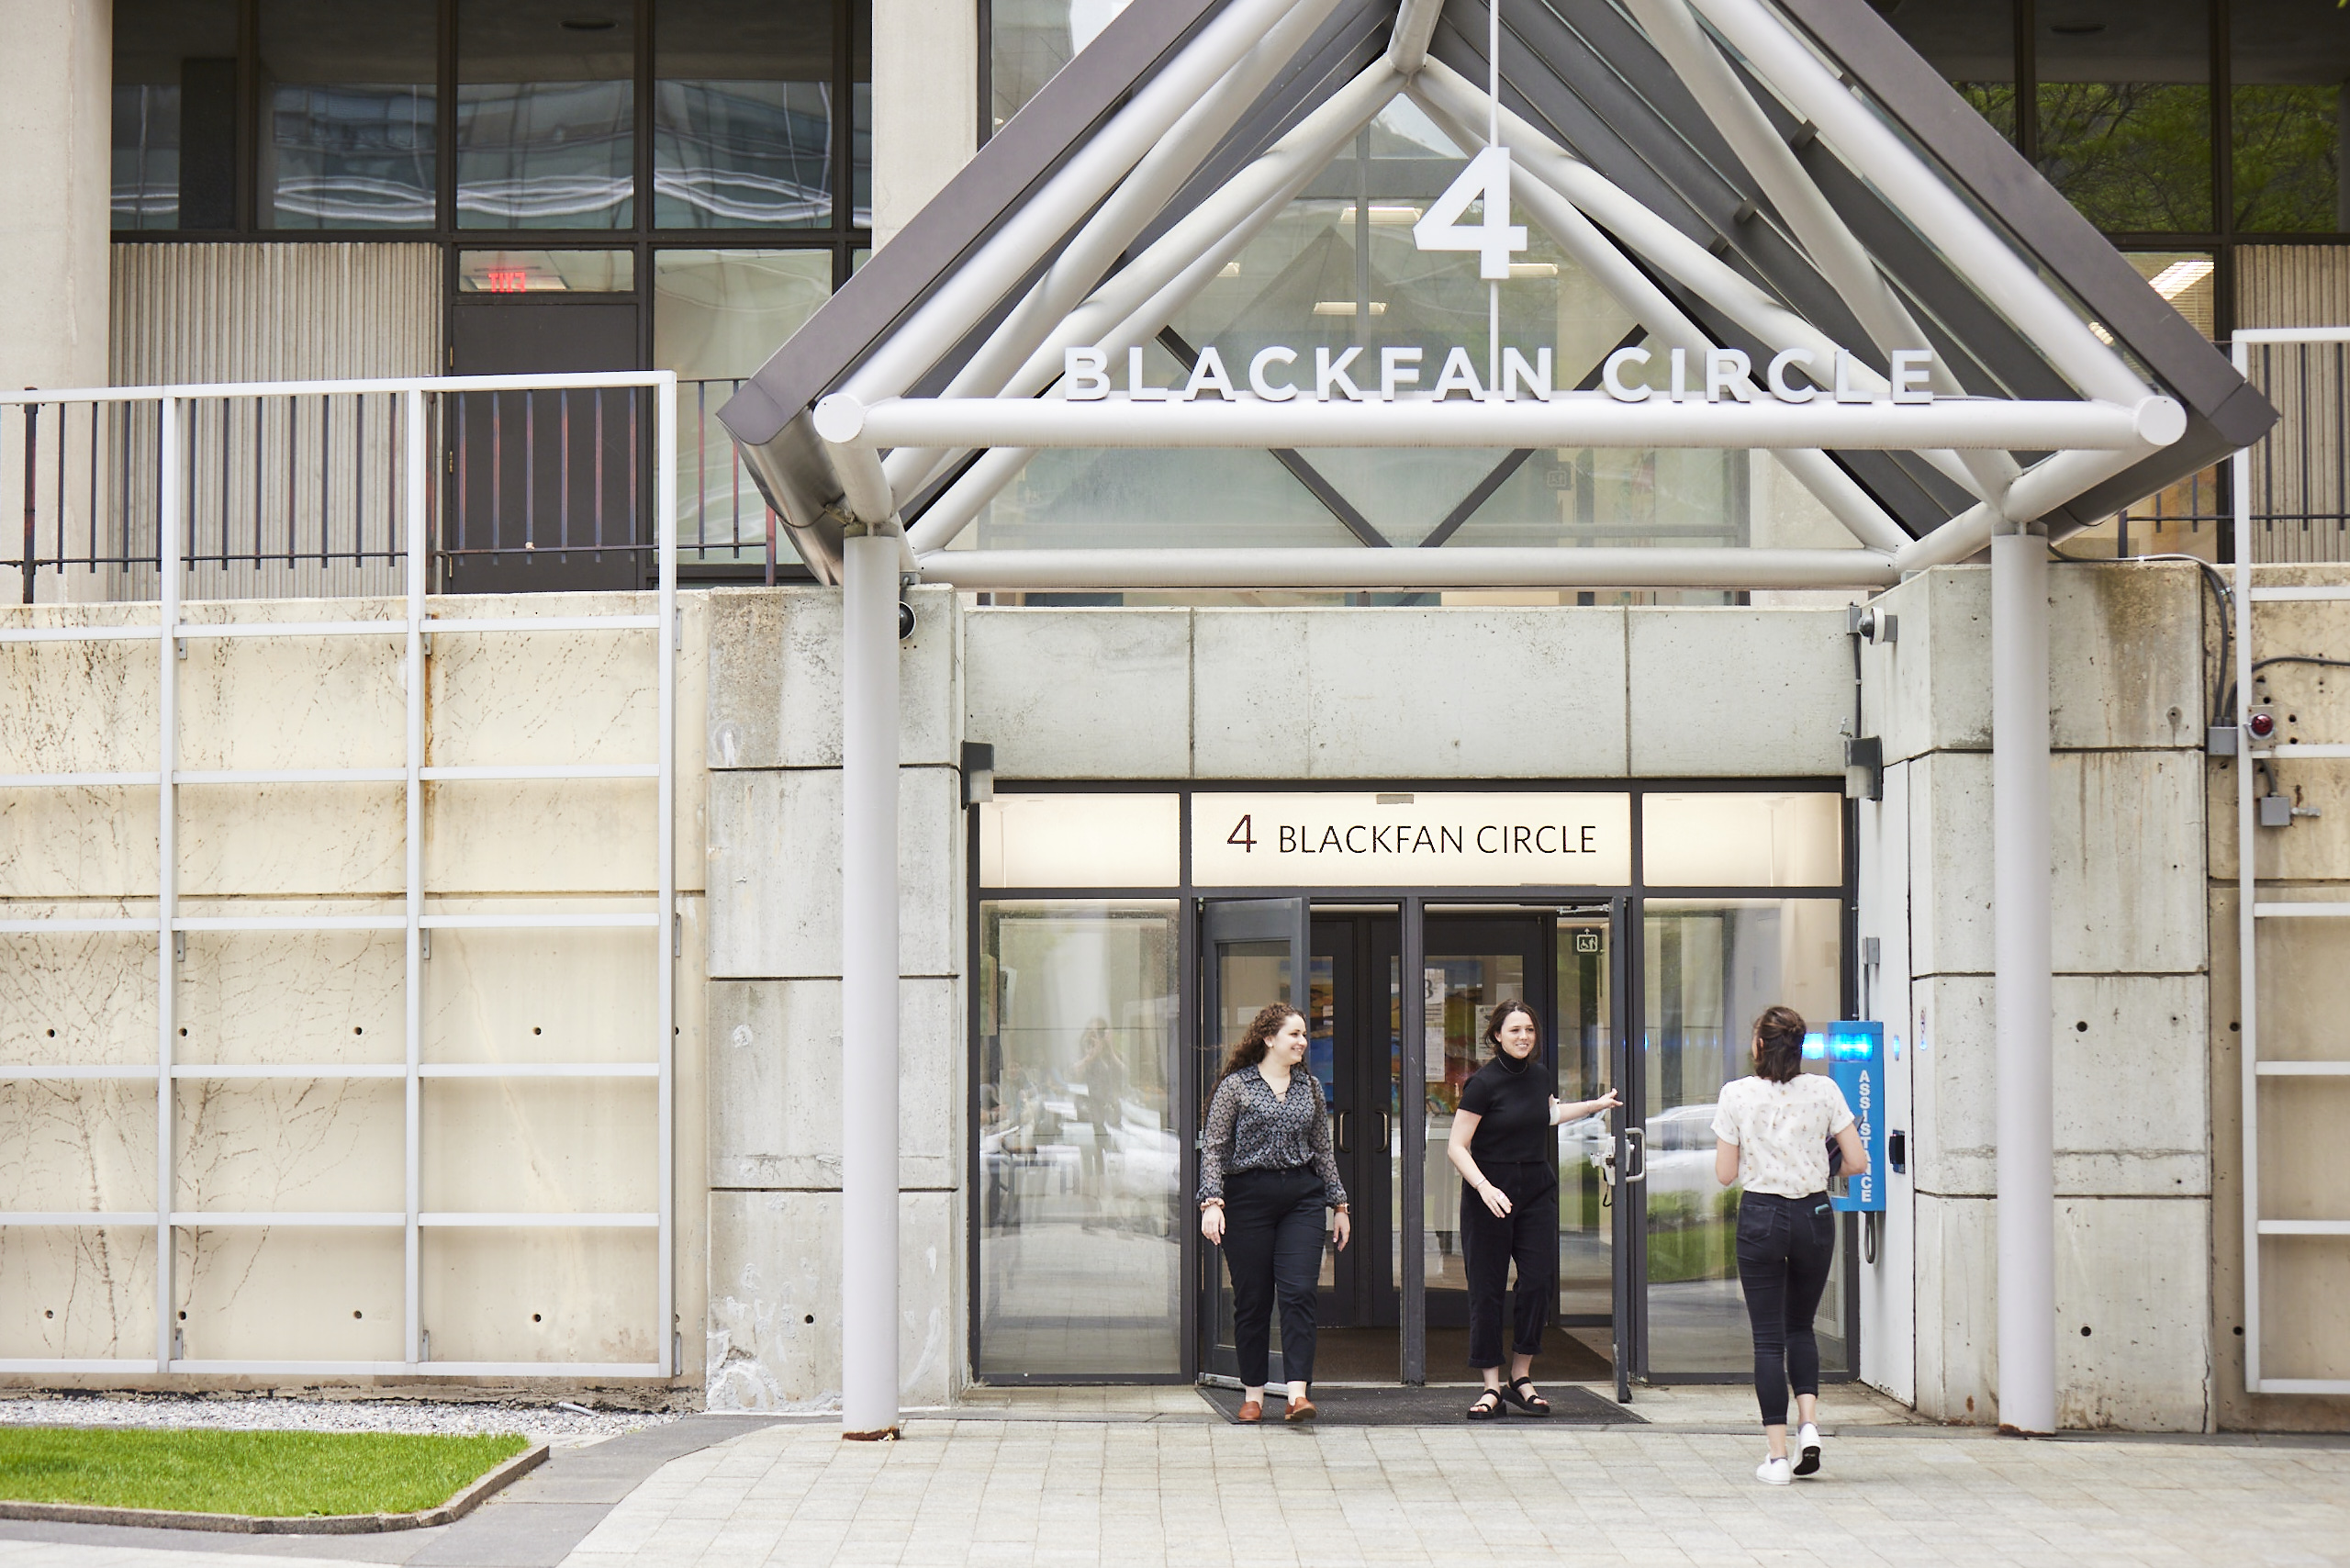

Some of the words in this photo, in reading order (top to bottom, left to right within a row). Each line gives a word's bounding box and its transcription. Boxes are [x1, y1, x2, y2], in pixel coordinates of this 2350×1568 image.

[1413, 147, 1528, 279] 4
[1064, 345, 1553, 402] BLACKFAN
[1602, 346, 1934, 404] CIRCLE
[1227, 814, 1257, 853] 4
[1280, 825, 1462, 854] BLACKFAN
[1477, 825, 1596, 854] CIRCLE
